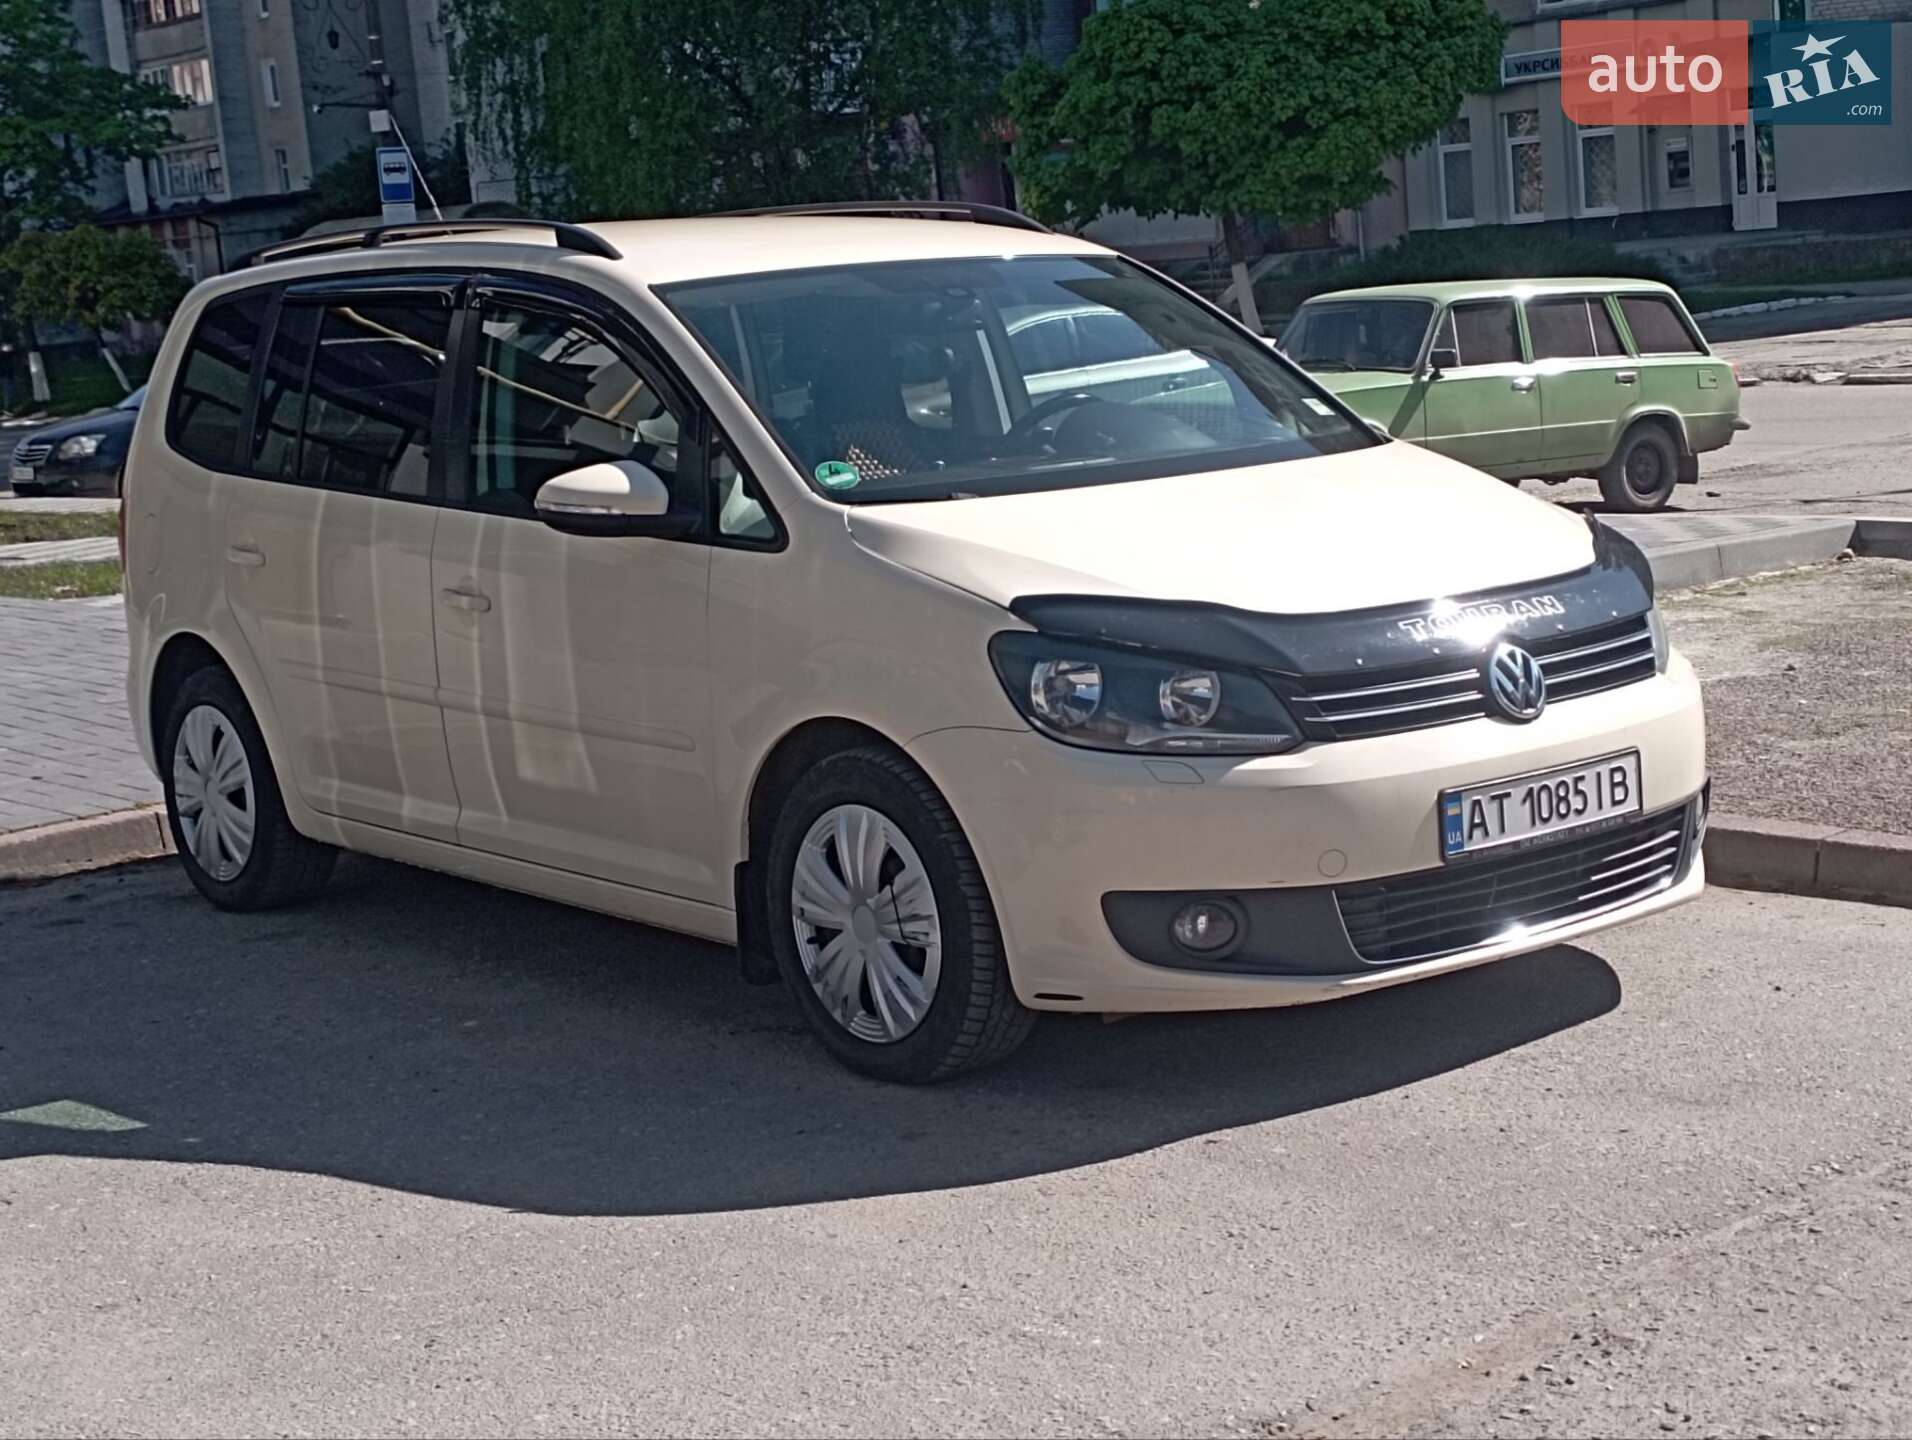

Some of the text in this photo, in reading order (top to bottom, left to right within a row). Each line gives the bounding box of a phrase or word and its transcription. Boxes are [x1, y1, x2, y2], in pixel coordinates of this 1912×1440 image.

[1467, 765, 1630, 840] AT 1085 IB
[1448, 831, 1462, 846] UA
